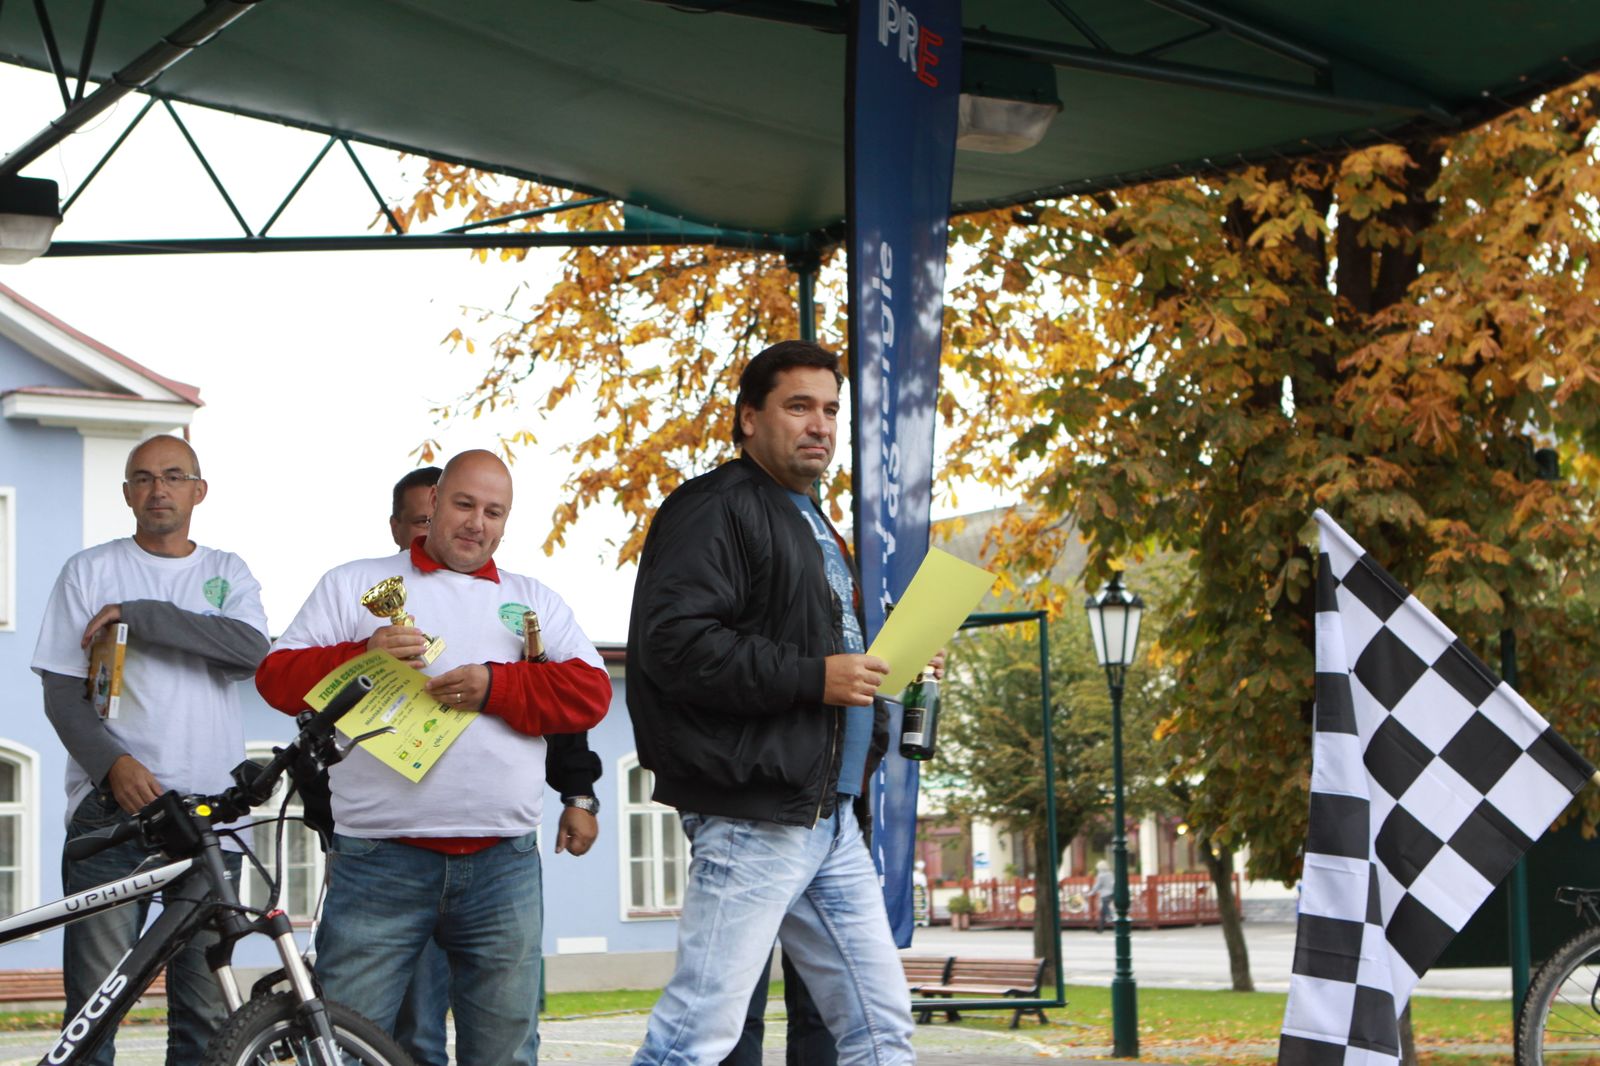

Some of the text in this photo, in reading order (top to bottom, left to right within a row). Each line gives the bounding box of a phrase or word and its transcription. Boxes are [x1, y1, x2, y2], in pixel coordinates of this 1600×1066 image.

[878, 0, 944, 88] PRE
[65, 874, 165, 912] UPHILL
[47, 971, 128, 1065] GOGS
